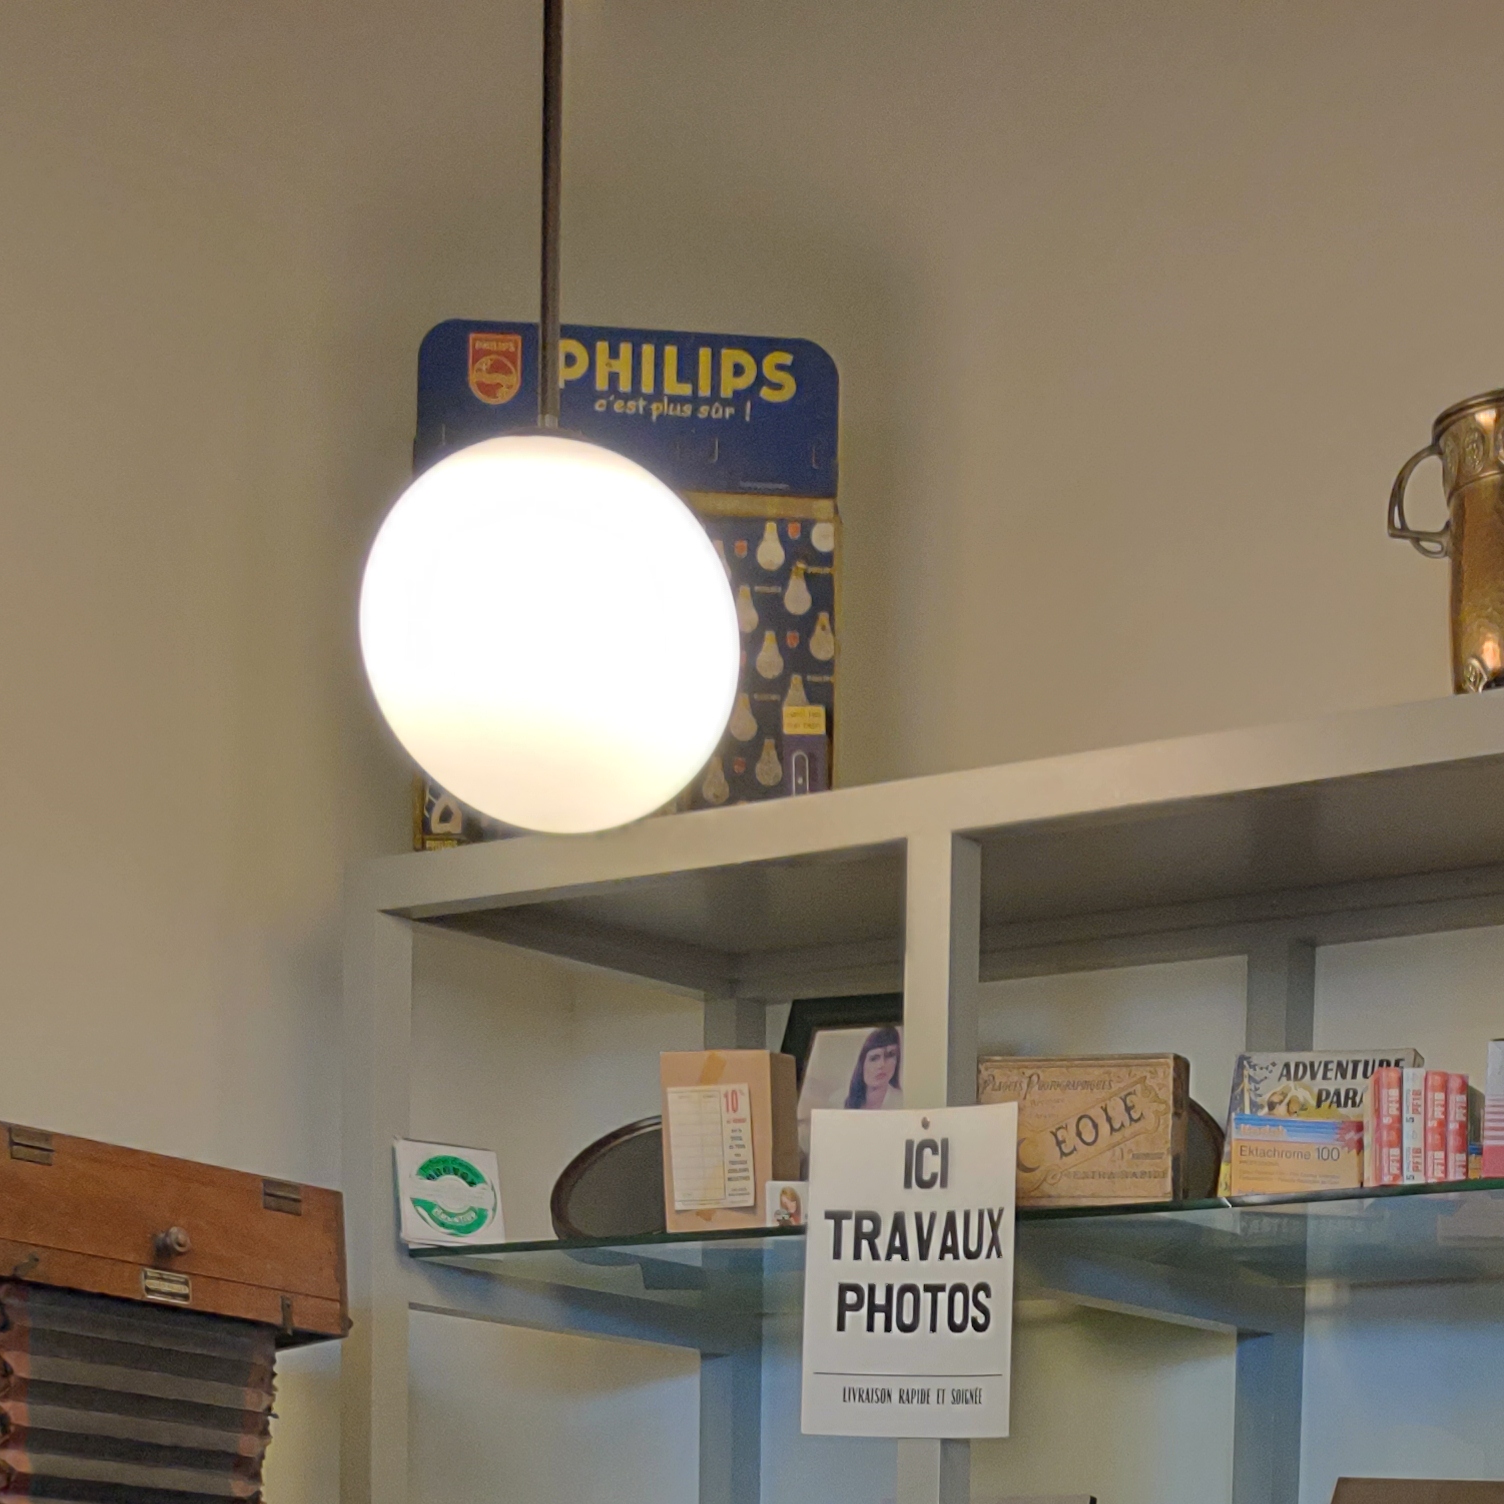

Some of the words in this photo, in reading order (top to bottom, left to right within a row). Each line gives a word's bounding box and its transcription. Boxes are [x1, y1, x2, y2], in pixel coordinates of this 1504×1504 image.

[558, 337, 797, 403] PHILIPS
[650, 396, 693, 422] plus
[698, 401, 736, 420] sûr
[1412, 1089, 1422, 1115] PF1B
[1049, 1089, 1146, 1161] EOLE
[903, 1137, 949, 1190] ICI
[1239, 1144, 1312, 1161] Ektachrome
[1315, 1146, 1341, 1162] 100
[1412, 1147, 1422, 1173] PF1B
[824, 1206, 1004, 1263] TRAVAUX
[836, 1281, 992, 1334] PHOTOS
[842, 1386, 893, 1404] LIVRAISON
[898, 1387, 931, 1405] RAPIDE
[936, 1387, 946, 1405] ET
[950, 1386, 983, 1405] SOIGNÉE
